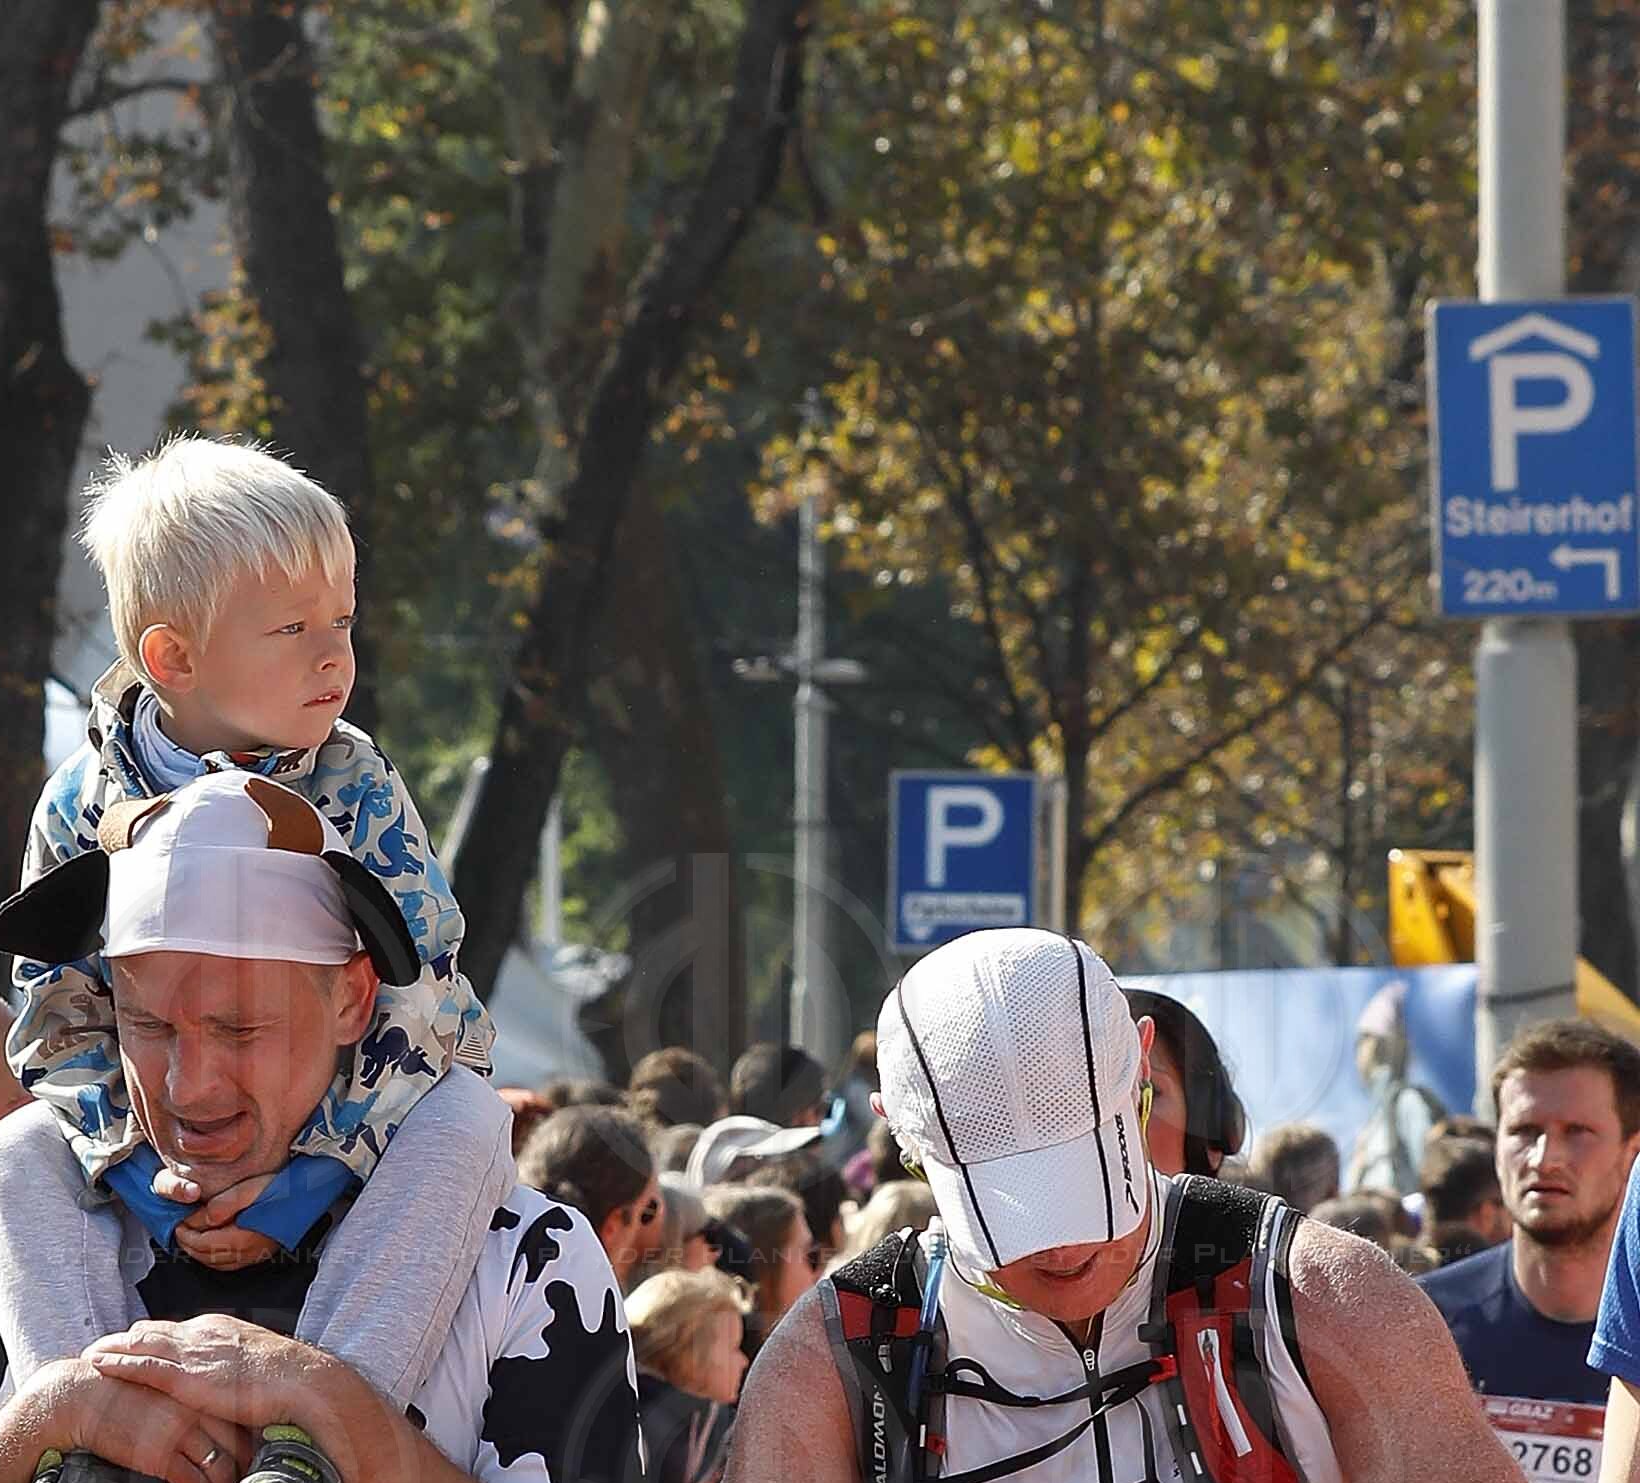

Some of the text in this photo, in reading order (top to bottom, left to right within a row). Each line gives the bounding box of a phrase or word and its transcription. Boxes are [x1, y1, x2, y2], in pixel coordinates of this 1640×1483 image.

[1489, 352, 1596, 492] P
[1446, 492, 1633, 537] Steirerhof
[926, 785, 1004, 888] P
